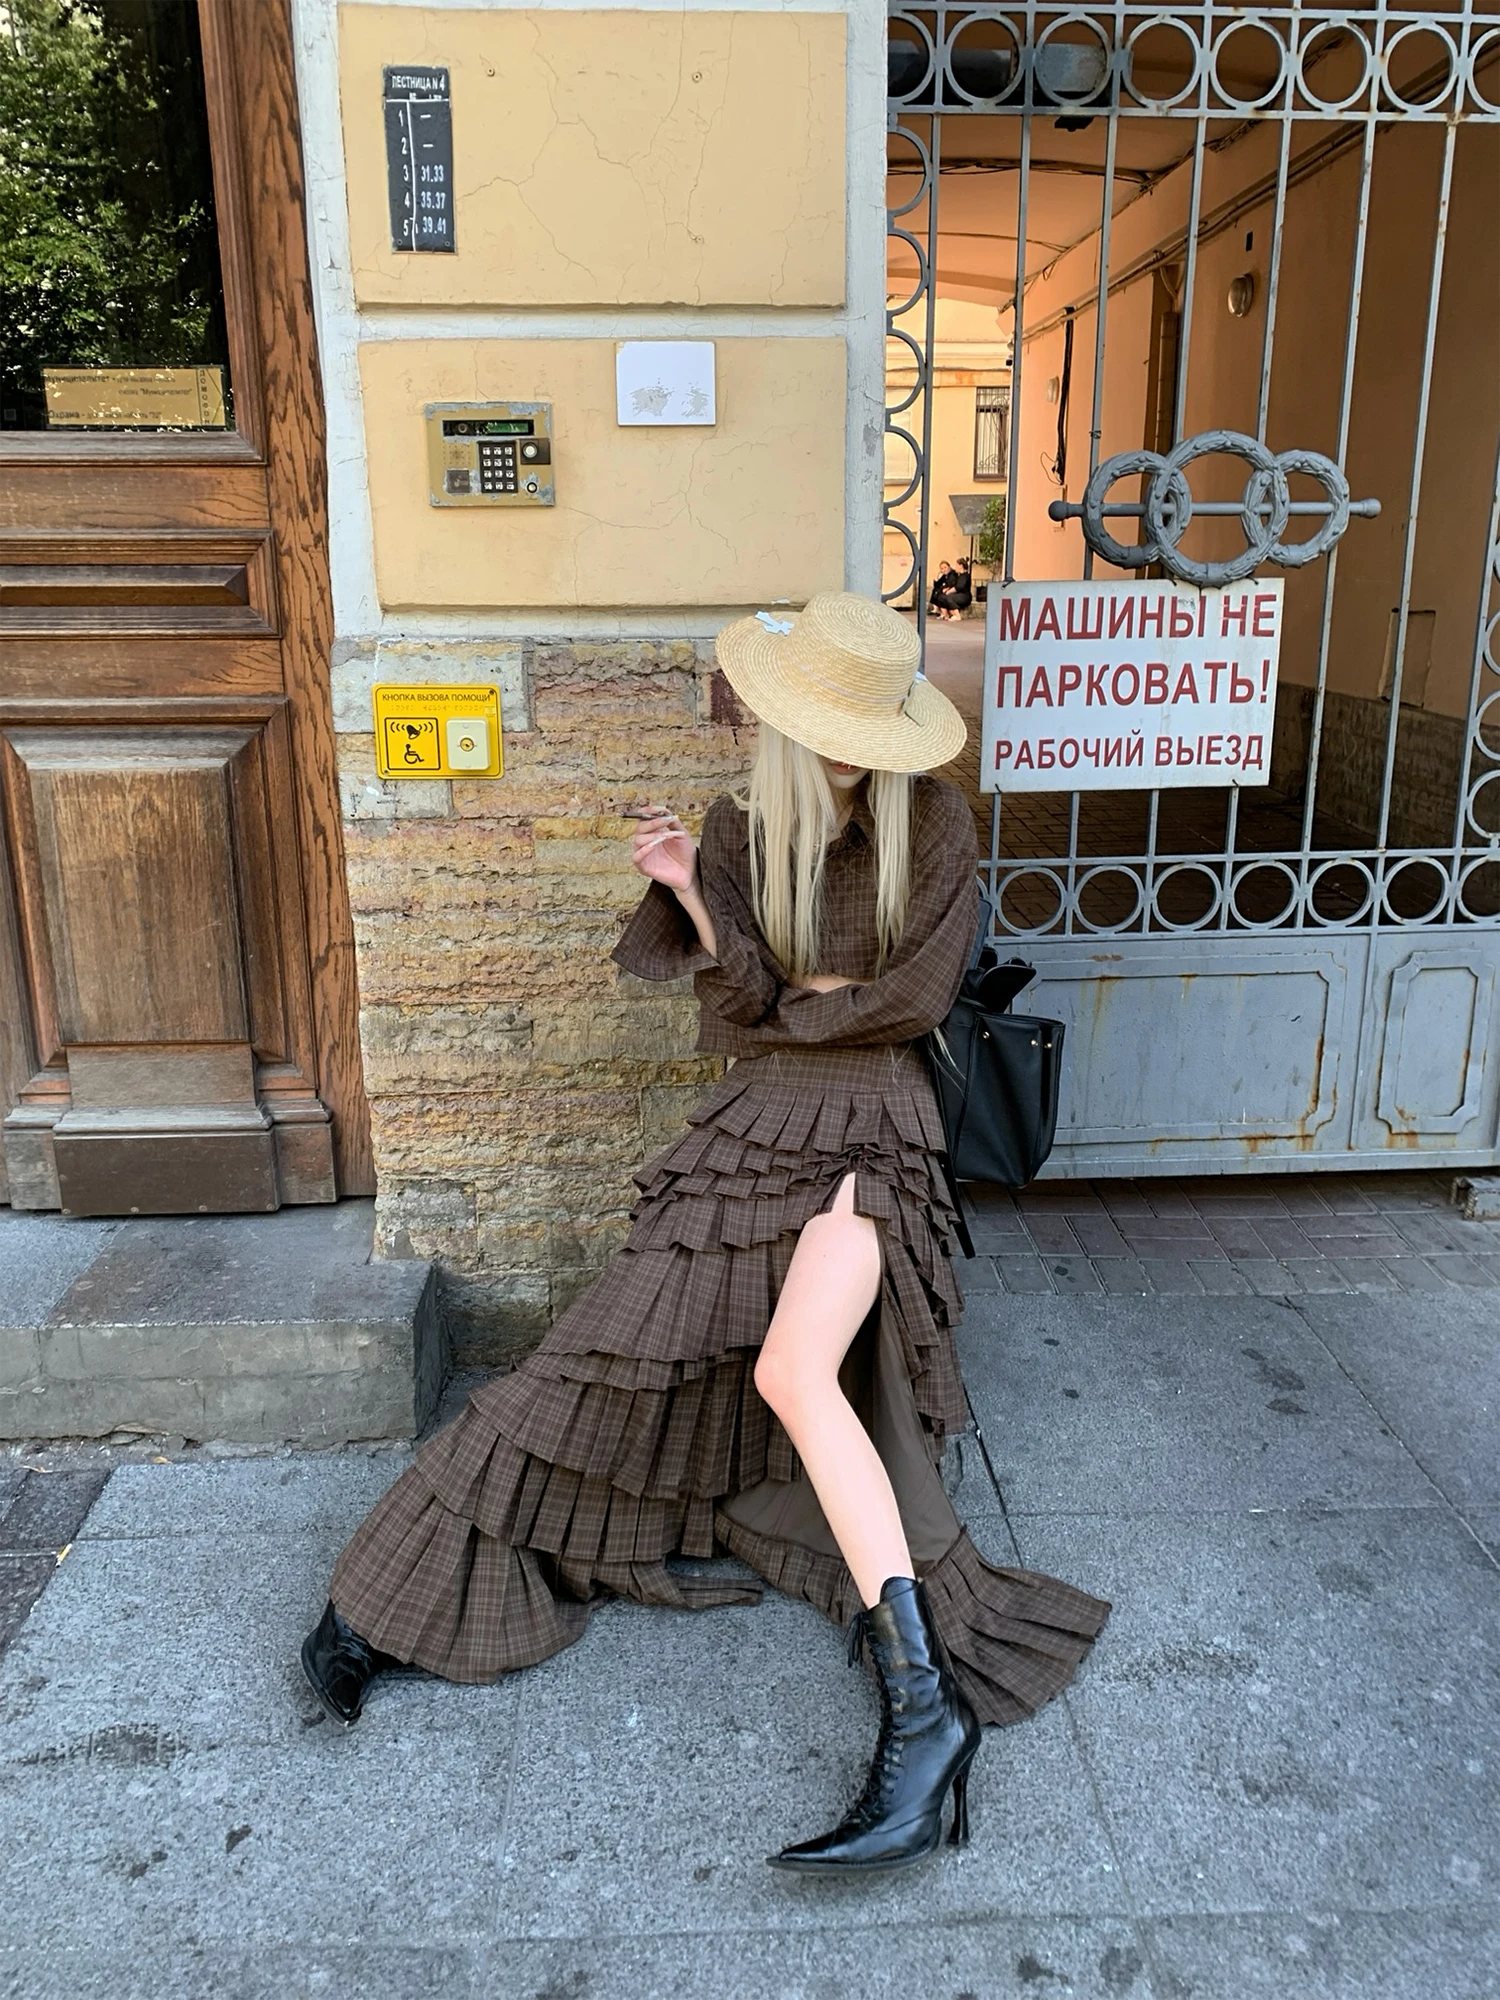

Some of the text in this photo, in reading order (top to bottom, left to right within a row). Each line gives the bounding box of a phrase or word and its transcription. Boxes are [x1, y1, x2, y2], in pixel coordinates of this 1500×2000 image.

[401, 136, 408, 155] 2
[403, 163, 409, 182] 3
[404, 191, 446, 209] 4 35.37
[403, 218, 409, 237] 5
[1000, 594, 1277, 641] МАШИНЫ НЕ
[997, 659, 1270, 708] ПАРКОВАТЬ!
[382, 693, 490, 703] КНОПКА ВЫЗОВА ПОМОЩИ
[994, 729, 1264, 771] РАБОЧИЙ ВЫЕЗД
